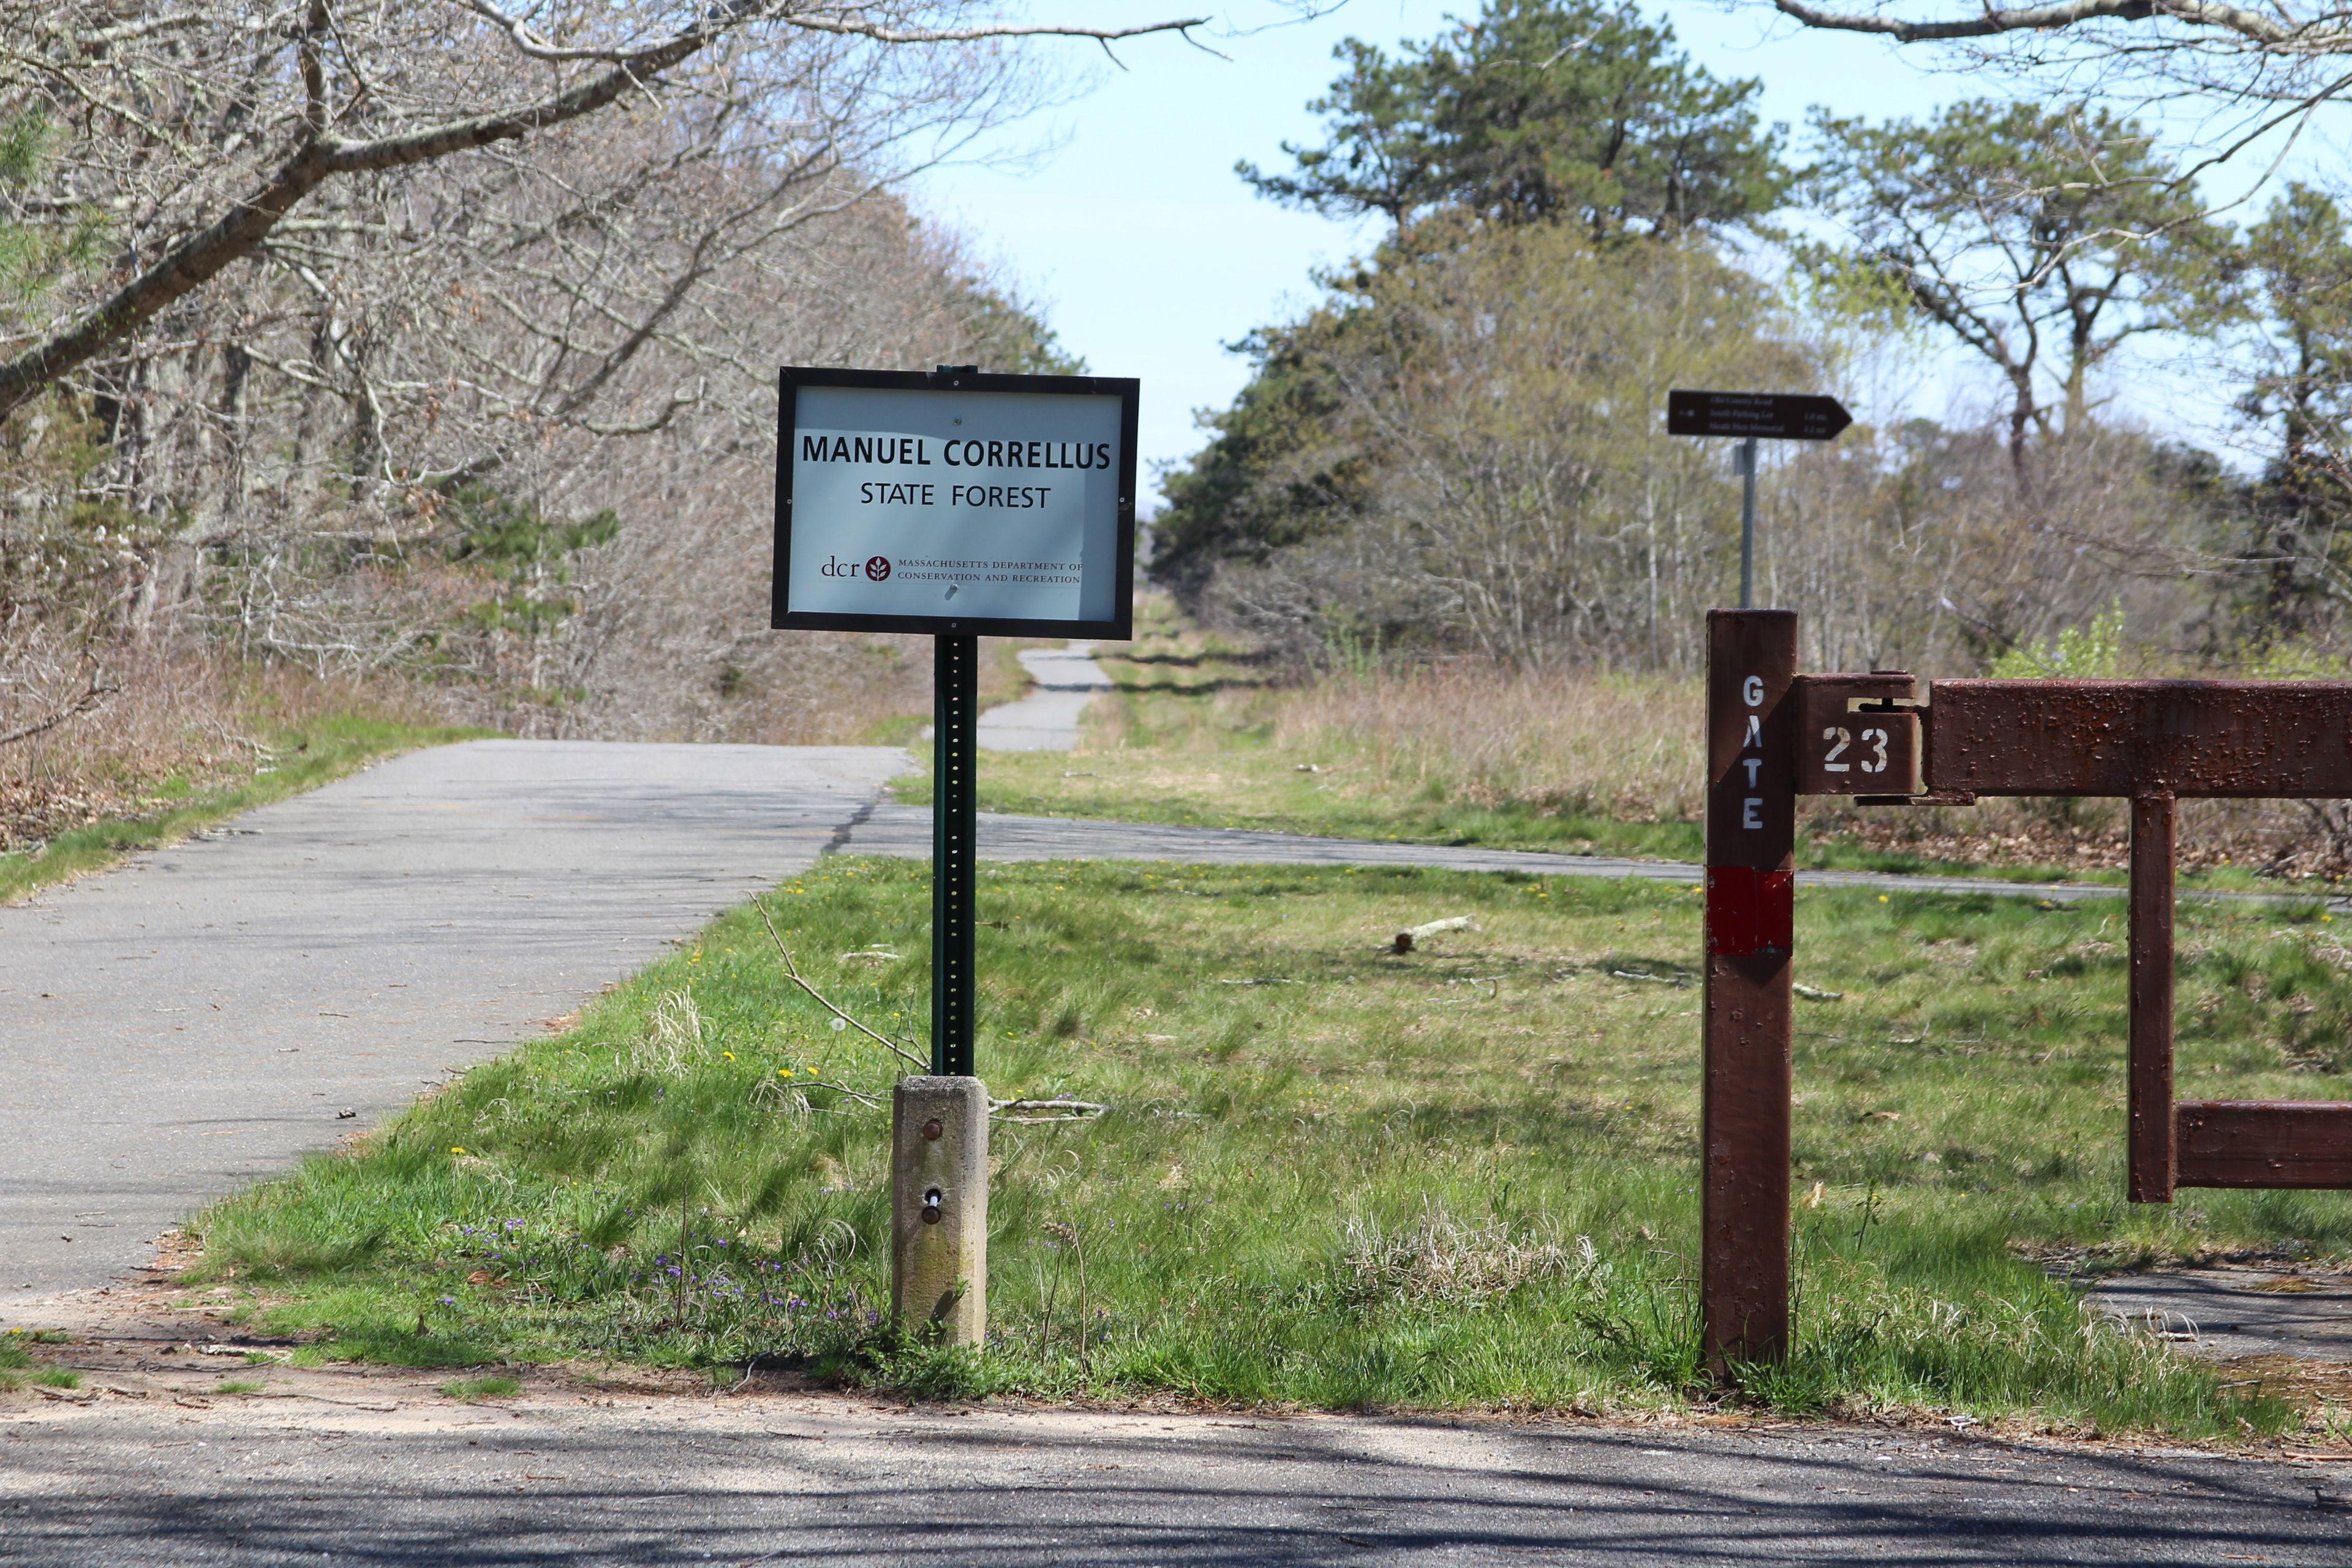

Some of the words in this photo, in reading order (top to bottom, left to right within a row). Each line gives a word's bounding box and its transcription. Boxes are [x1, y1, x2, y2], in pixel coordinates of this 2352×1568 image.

[804, 436, 930, 465] MANUEL
[944, 440, 1110, 469] CORRELLUS
[862, 483, 933, 505] STATE
[953, 486, 1050, 508] FOREST
[822, 556, 859, 576] dcr
[898, 573, 980, 581] CONSERVATION
[1012, 575, 1080, 584] RECREATION
[1743, 675, 1764, 829] GATE
[1823, 727, 1888, 772] 23
